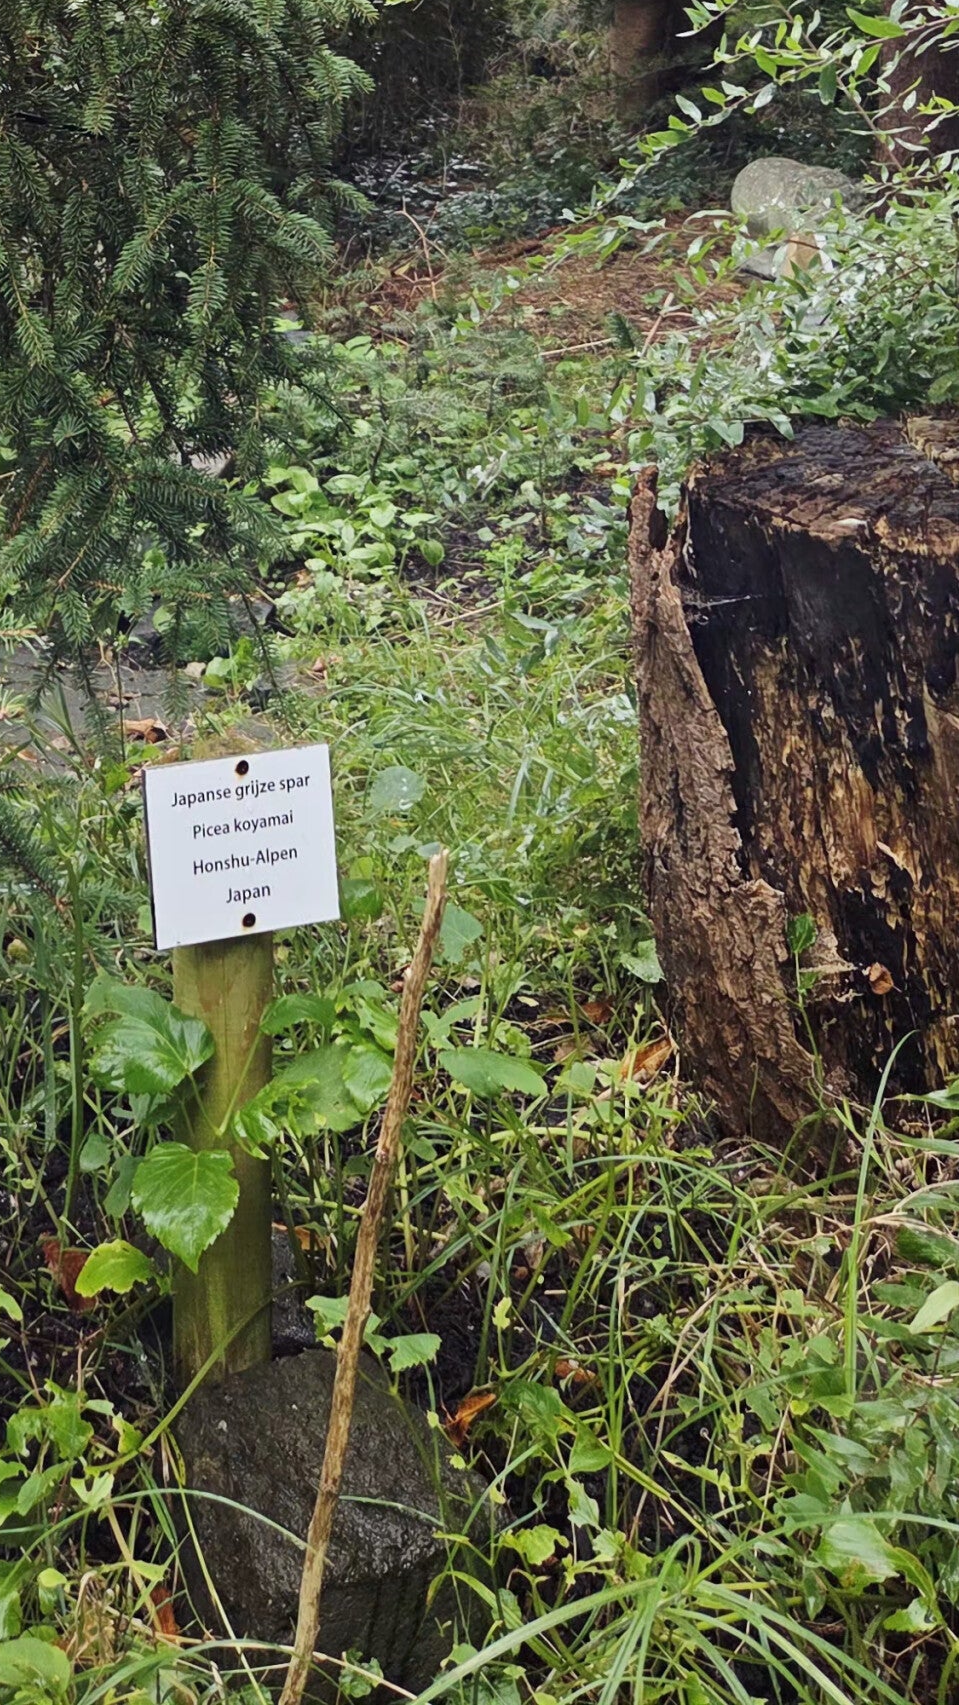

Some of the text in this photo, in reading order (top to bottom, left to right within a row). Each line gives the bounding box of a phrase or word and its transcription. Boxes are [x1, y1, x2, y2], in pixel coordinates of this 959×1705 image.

[171, 775, 311, 808] Japanse grijze spar
[192, 810, 294, 839] Picea koyamai
[193, 847, 298, 875] Honshu-Alpen
[226, 884, 271, 904] Japan
